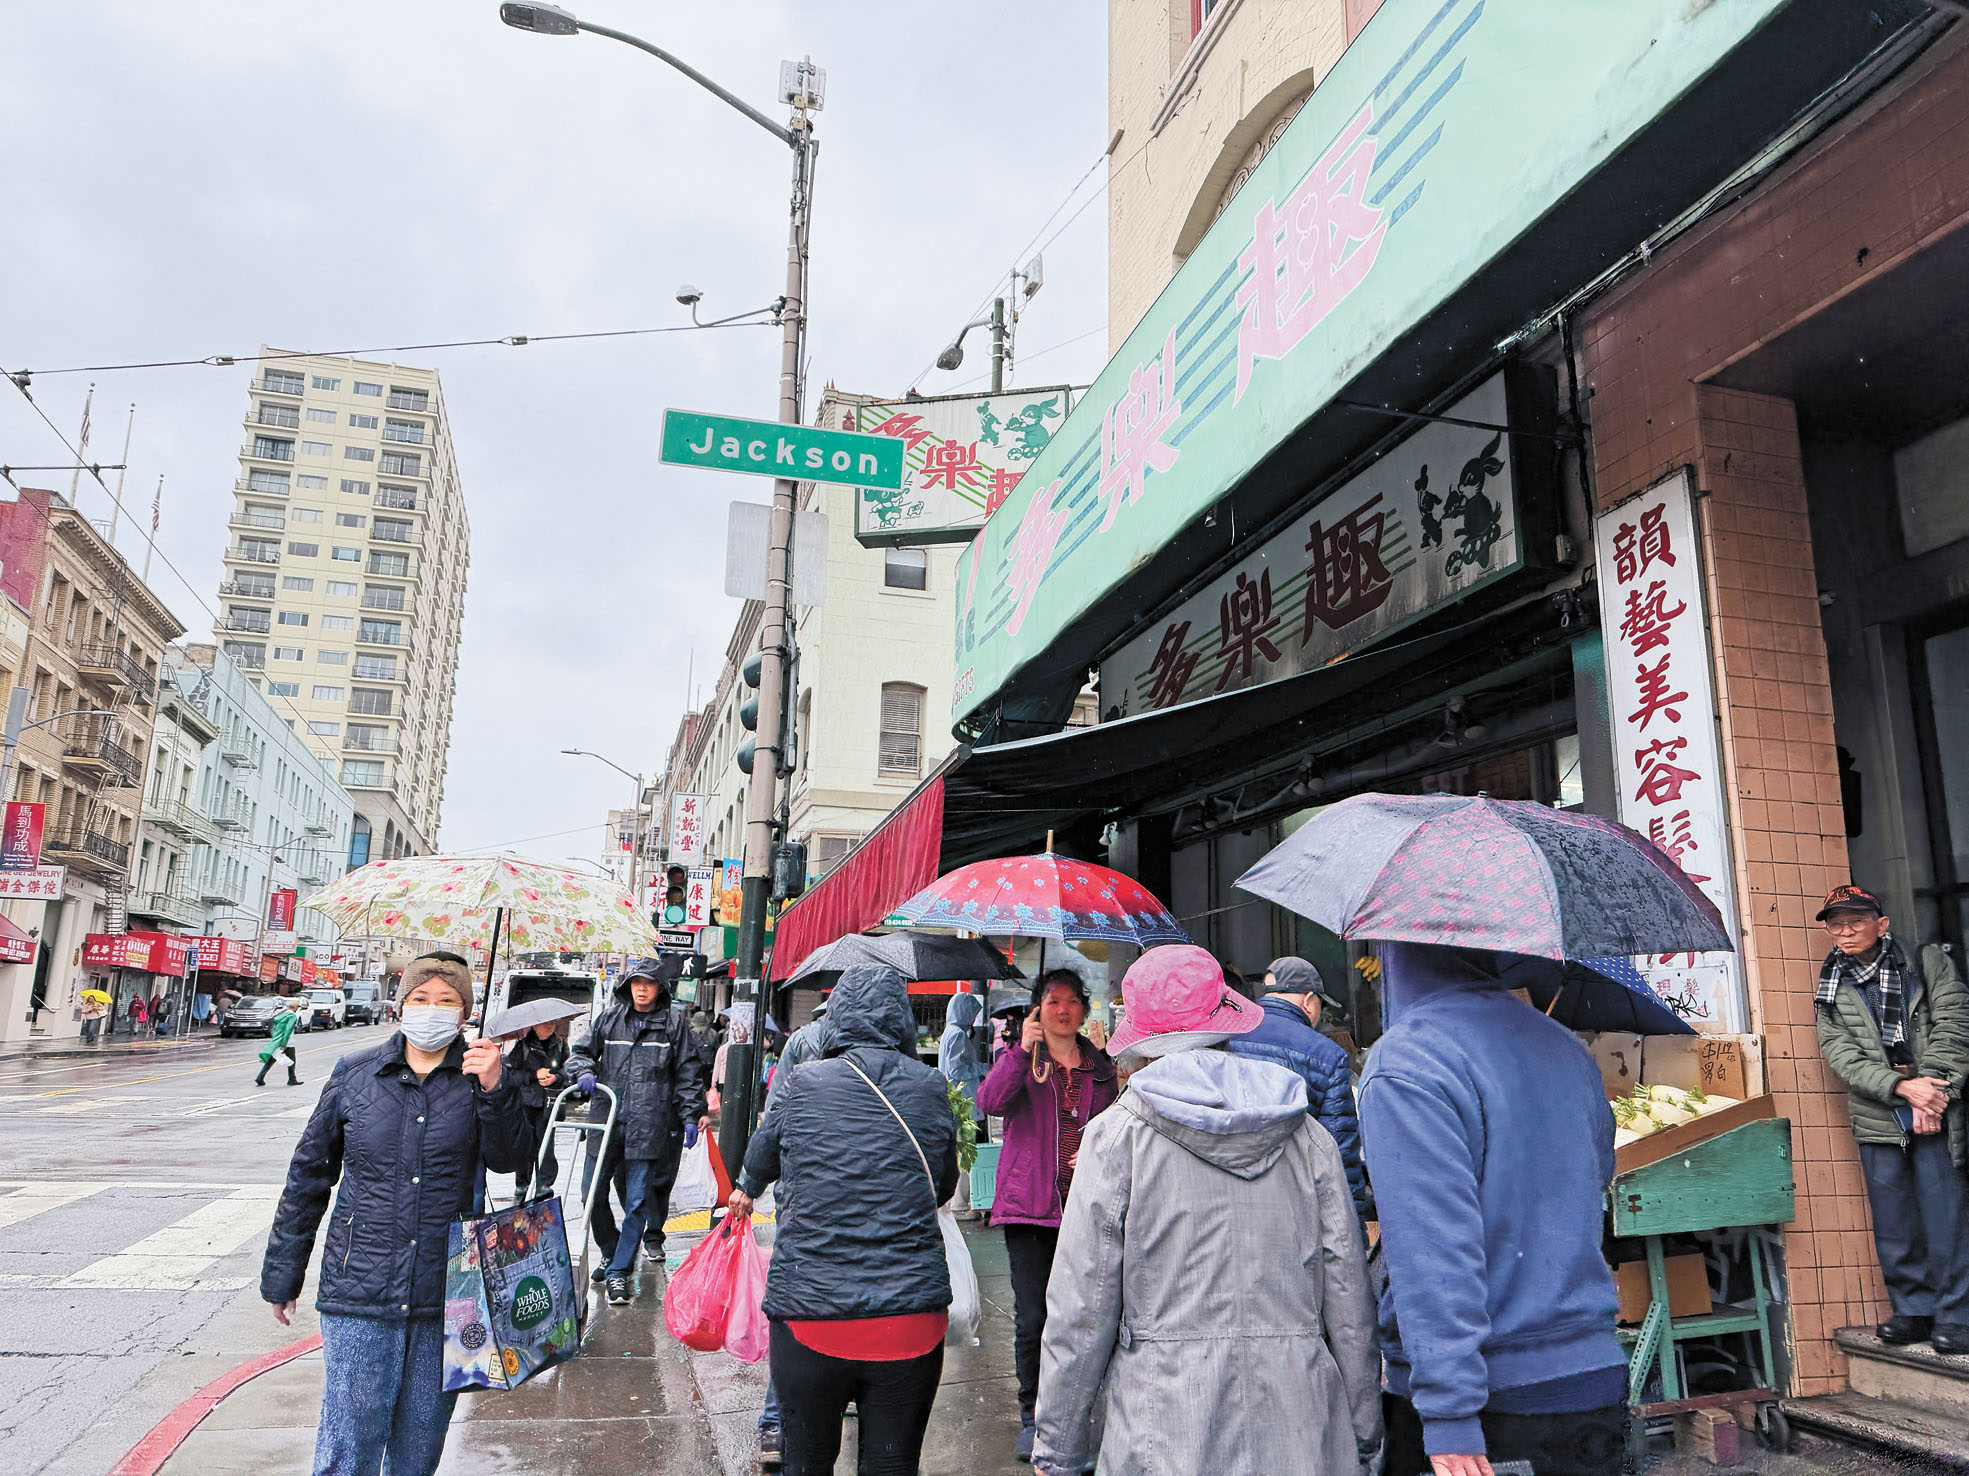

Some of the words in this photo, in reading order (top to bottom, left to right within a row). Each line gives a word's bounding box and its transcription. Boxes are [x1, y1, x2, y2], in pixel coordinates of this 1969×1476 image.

[689, 427, 878, 476] Jackson
[12, 805, 33, 852] 馬到功成
[28, 870, 62, 878] JEWELRY
[688, 871, 712, 880] WELLM
[688, 883, 704, 921] 康健
[517, 1289, 548, 1307] WHOLE
[516, 1299, 549, 1317] FOODS
